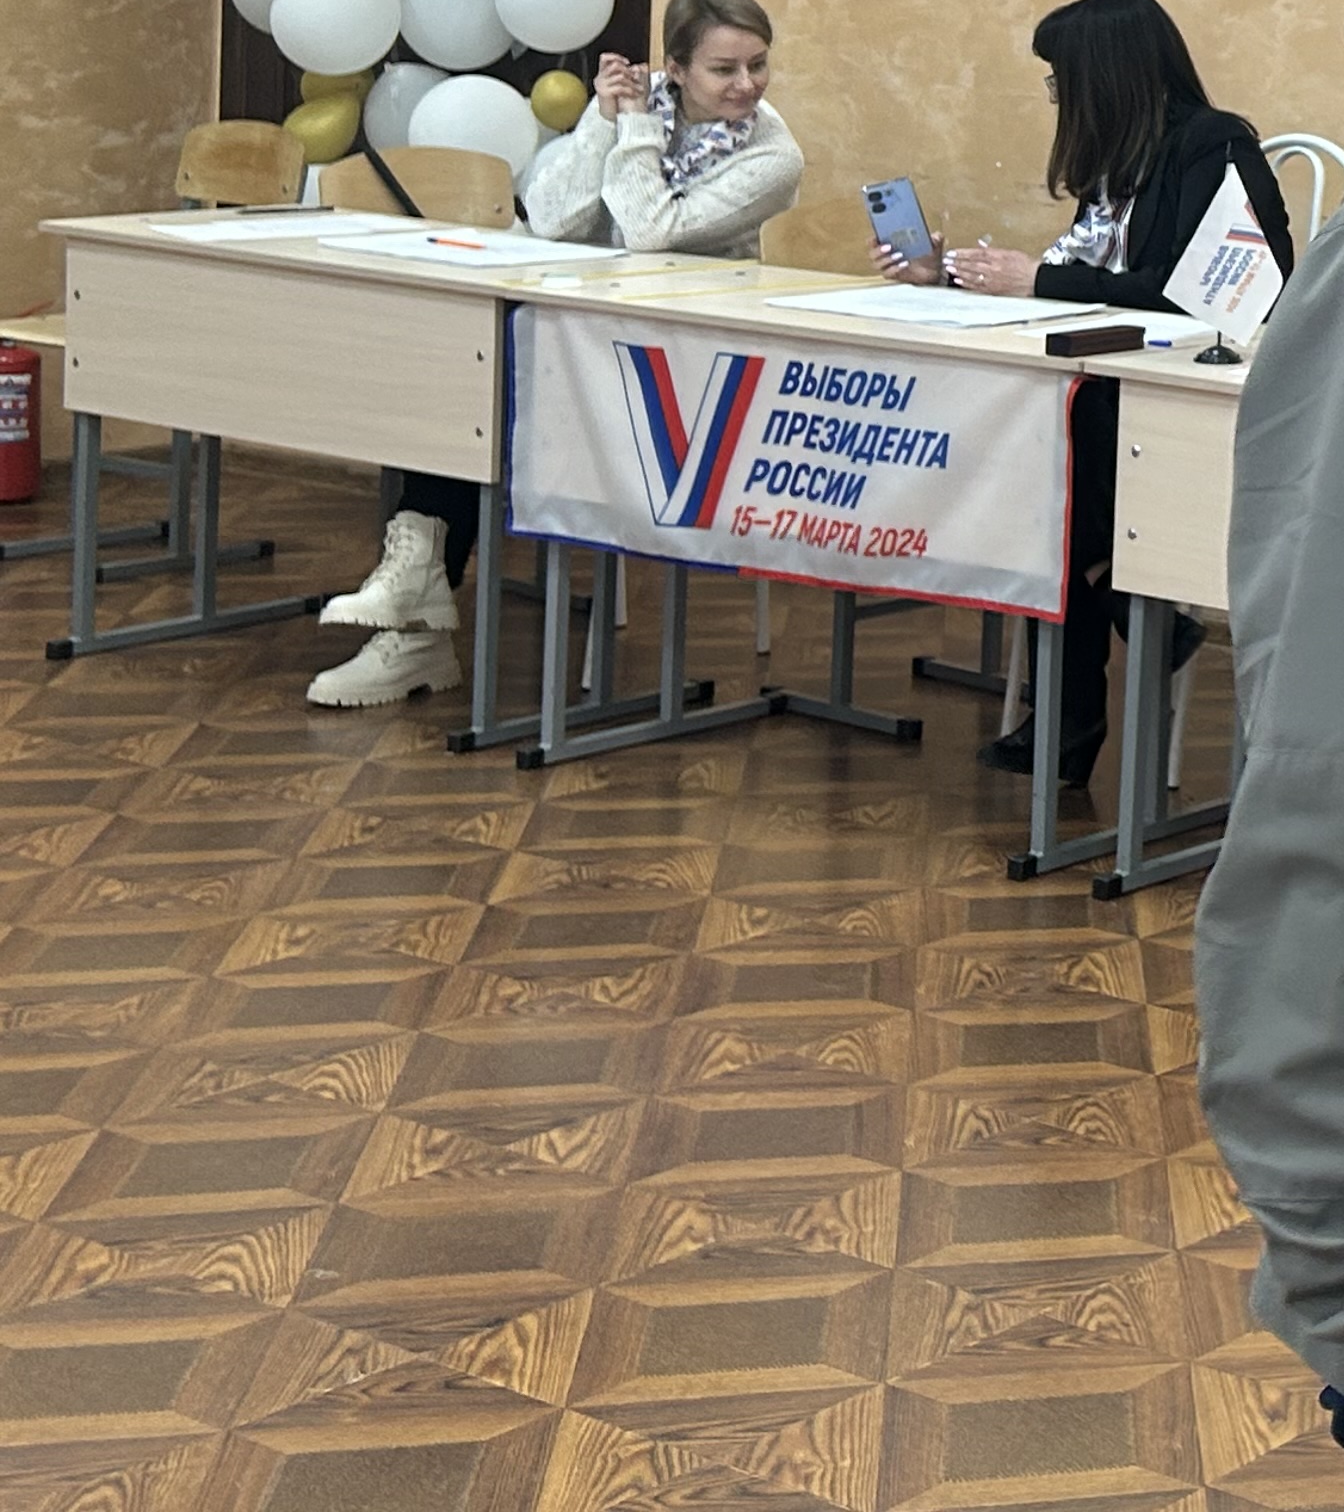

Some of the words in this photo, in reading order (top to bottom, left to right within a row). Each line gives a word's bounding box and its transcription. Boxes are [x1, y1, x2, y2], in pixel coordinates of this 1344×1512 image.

[779, 361, 916, 412] ВЫБОРЫ
[762, 410, 950, 469] ПРЕЗИДЕНТА
[744, 458, 866, 509] РОССИИ
[797, 513, 861, 556] МАРТА
[864, 527, 928, 558] 2024
